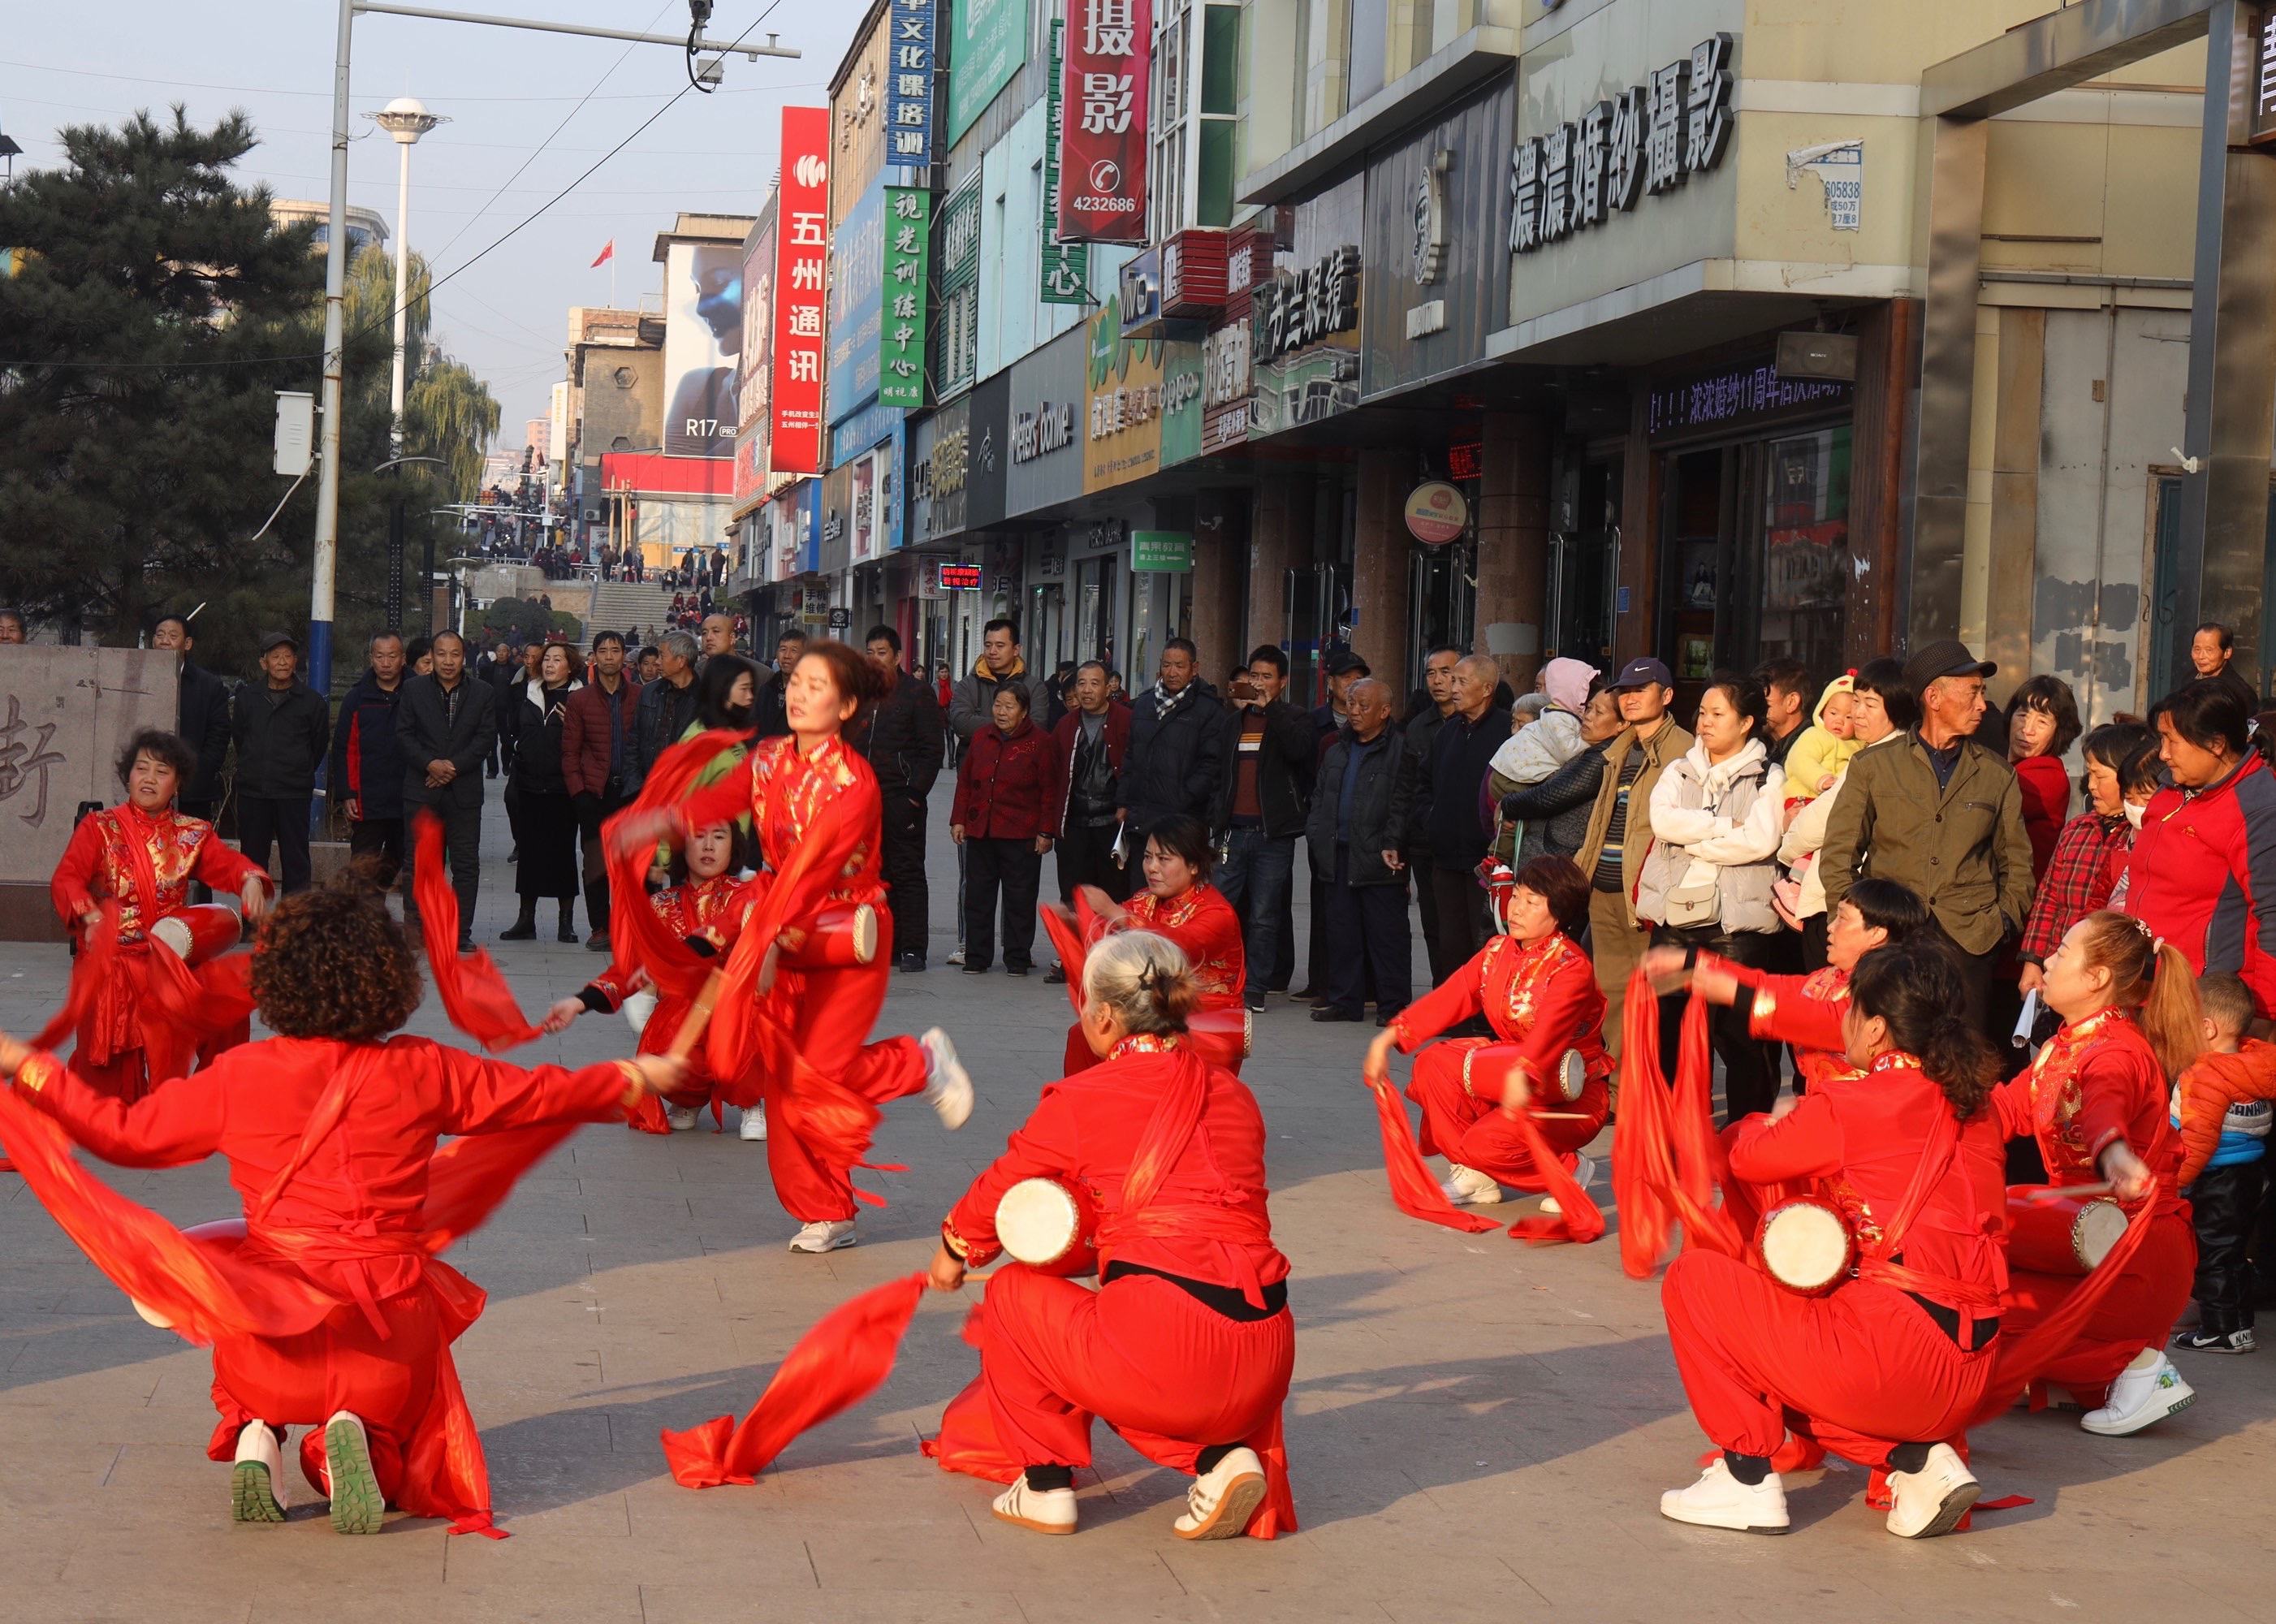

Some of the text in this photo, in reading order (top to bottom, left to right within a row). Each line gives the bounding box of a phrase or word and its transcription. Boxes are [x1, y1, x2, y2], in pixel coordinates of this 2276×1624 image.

[1073, 196, 1135, 213] 4232686
[890, 192, 922, 378] 视光训练中心
[789, 212, 826, 383] 五州通讯
[883, 386, 919, 399] 明视康
[686, 418, 718, 437] R17
[1139, 542, 1185, 552] 青果教育
[805, 589, 827, 601] 手机
[805, 602, 827, 615] 维修
